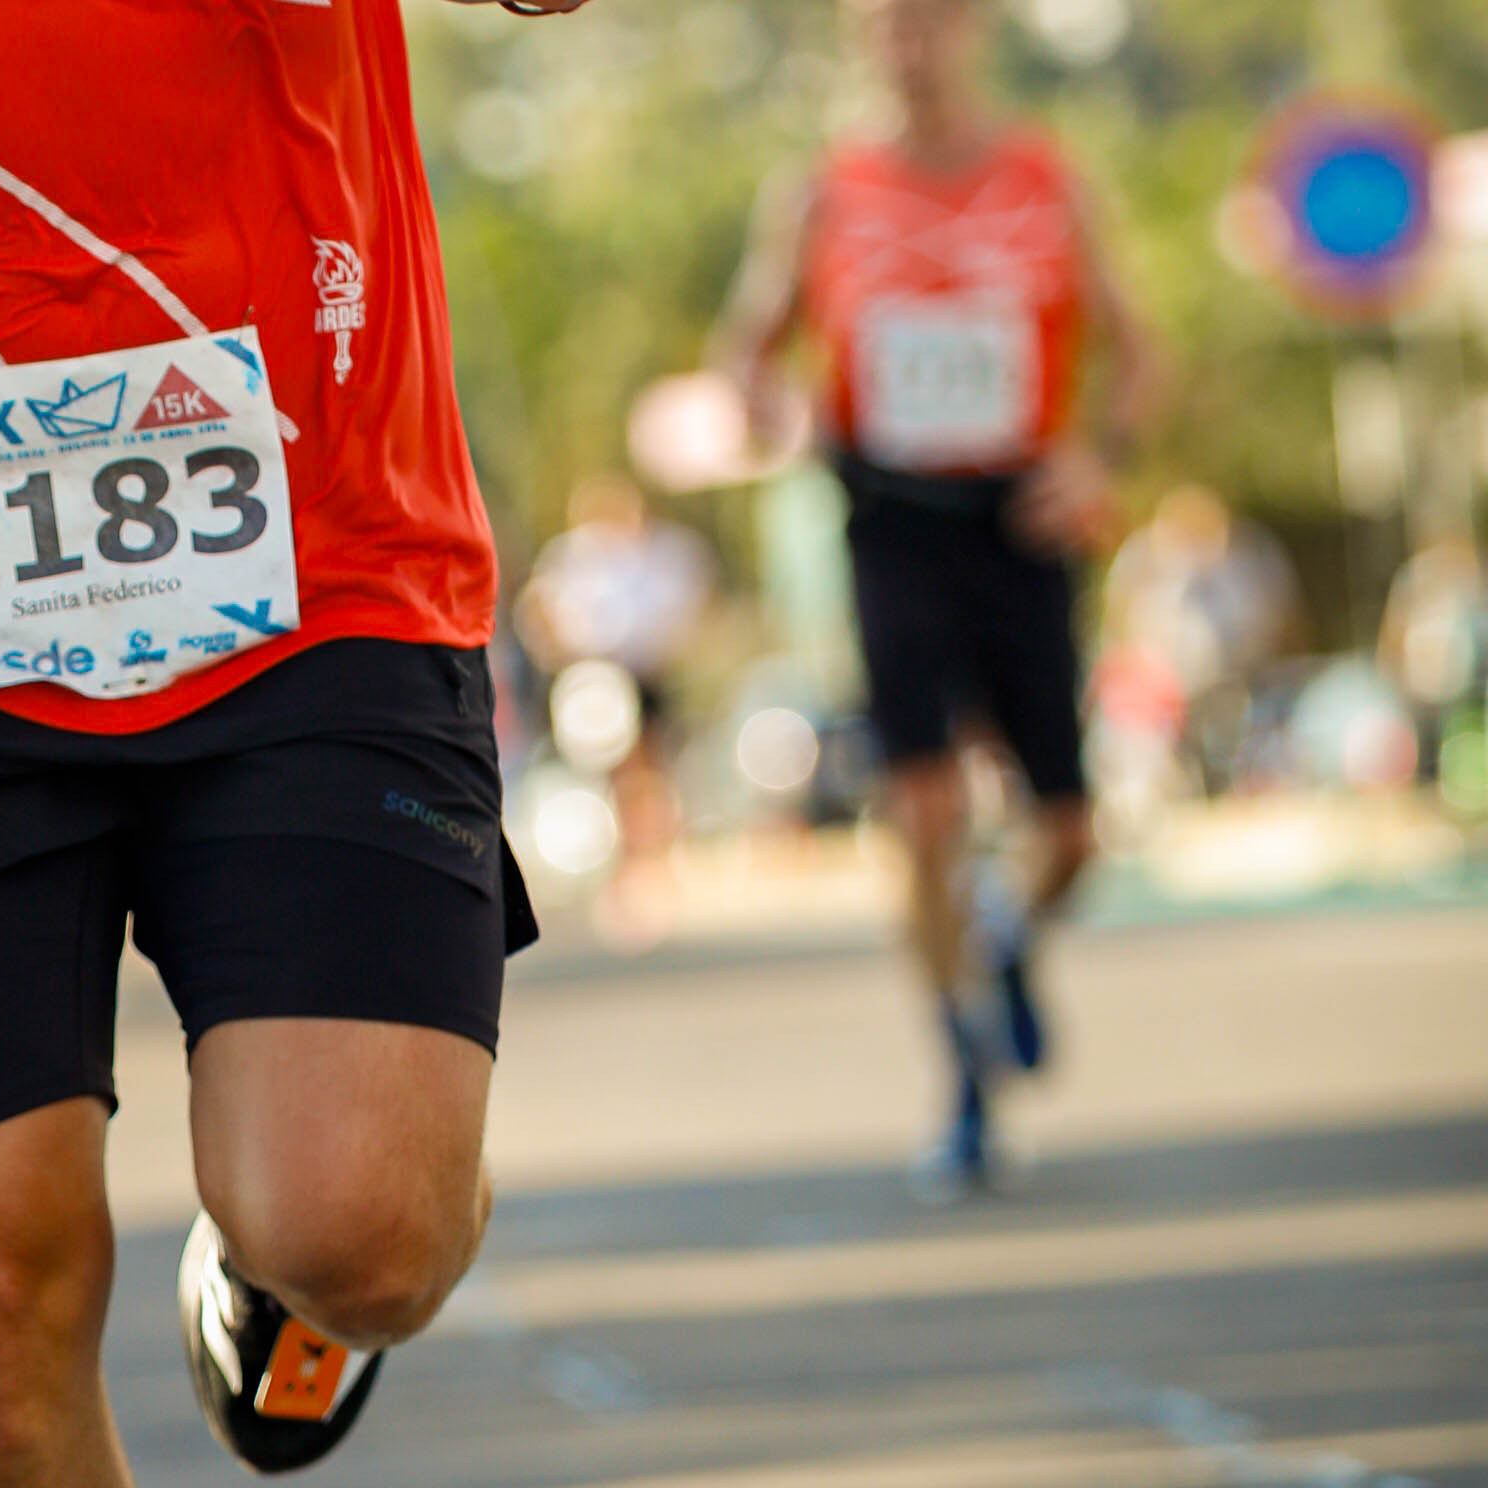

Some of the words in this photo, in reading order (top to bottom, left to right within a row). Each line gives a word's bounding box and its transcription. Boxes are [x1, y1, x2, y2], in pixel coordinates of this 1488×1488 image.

[151, 388, 208, 421] 15K
[12, 590, 81, 618] Sanita
[87, 573, 182, 606] Federico
[381, 789, 487, 860] saucony
